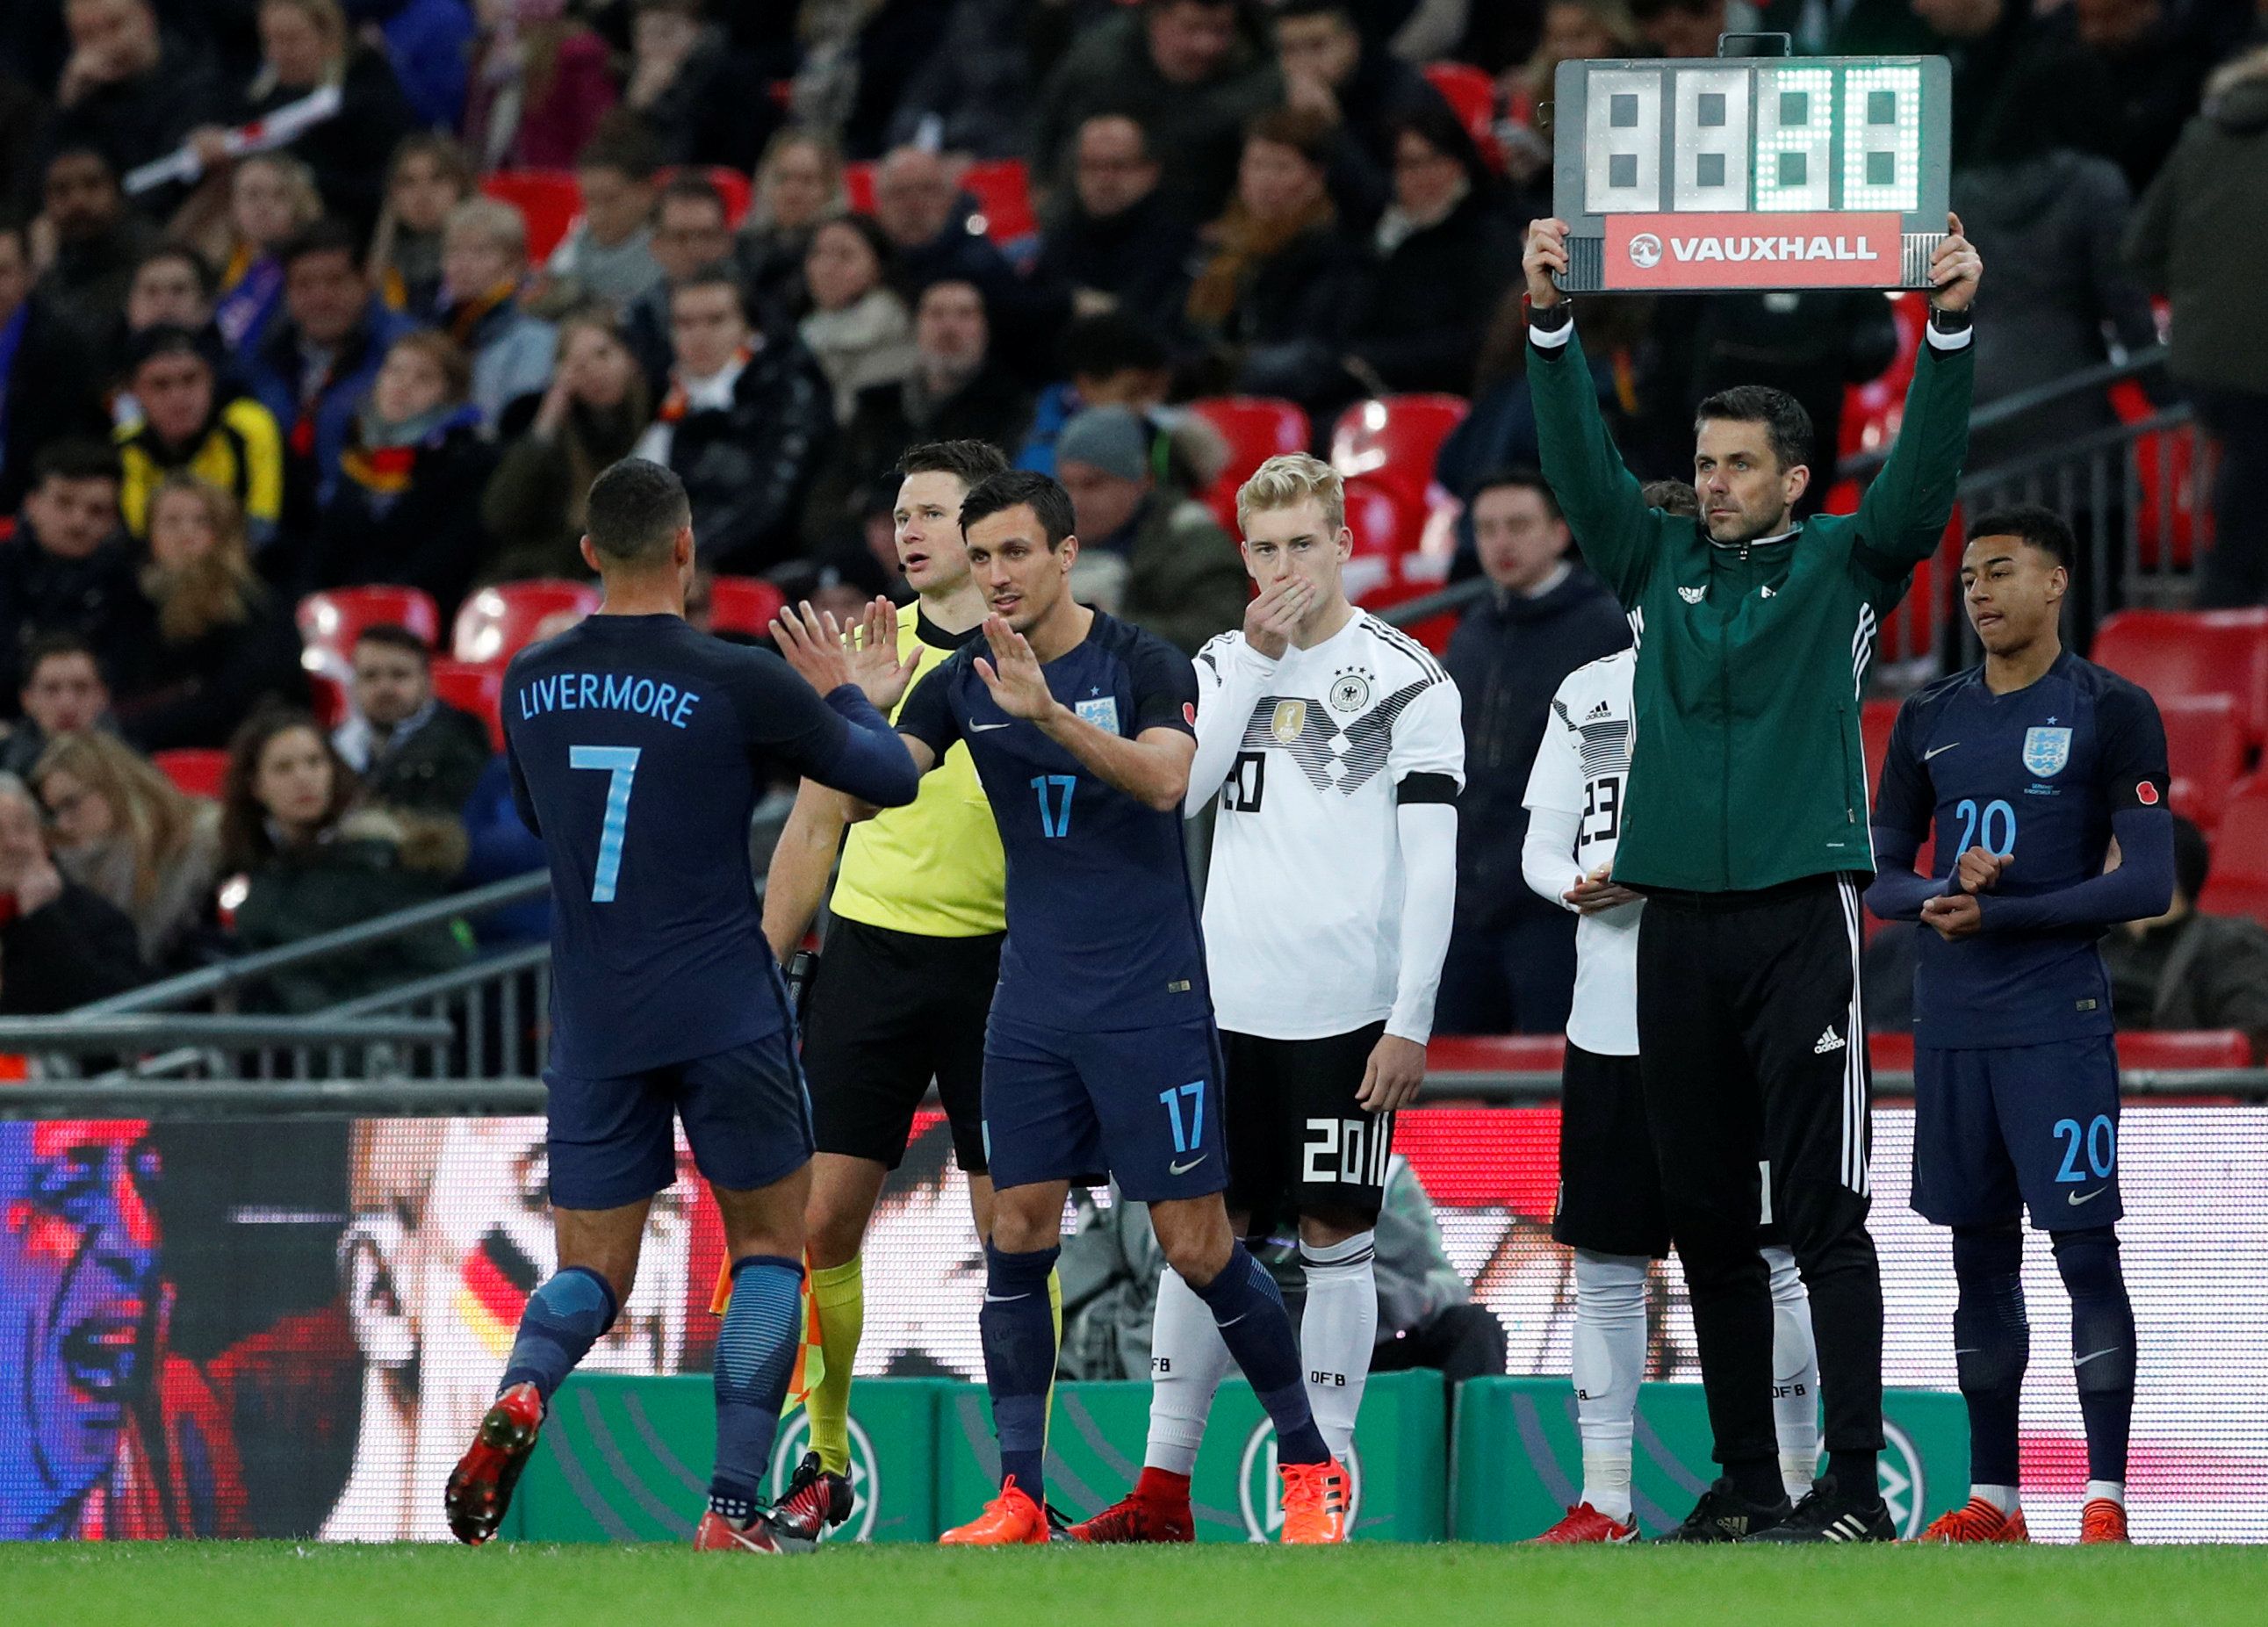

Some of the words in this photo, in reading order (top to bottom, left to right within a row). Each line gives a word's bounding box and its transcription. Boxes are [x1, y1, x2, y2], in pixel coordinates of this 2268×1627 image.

[1670, 236, 1878, 262] VAUXHALL
[520, 673, 701, 729] LIVERMORE
[569, 745, 642, 903] 7
[1030, 774, 1077, 838] 17
[1955, 798, 2017, 864] 20
[1814, 1037, 1846, 1055] adidas
[1159, 1080, 1205, 1153] 17
[2053, 1113, 2116, 1183] 20
[1302, 1118, 1365, 1185] 20
